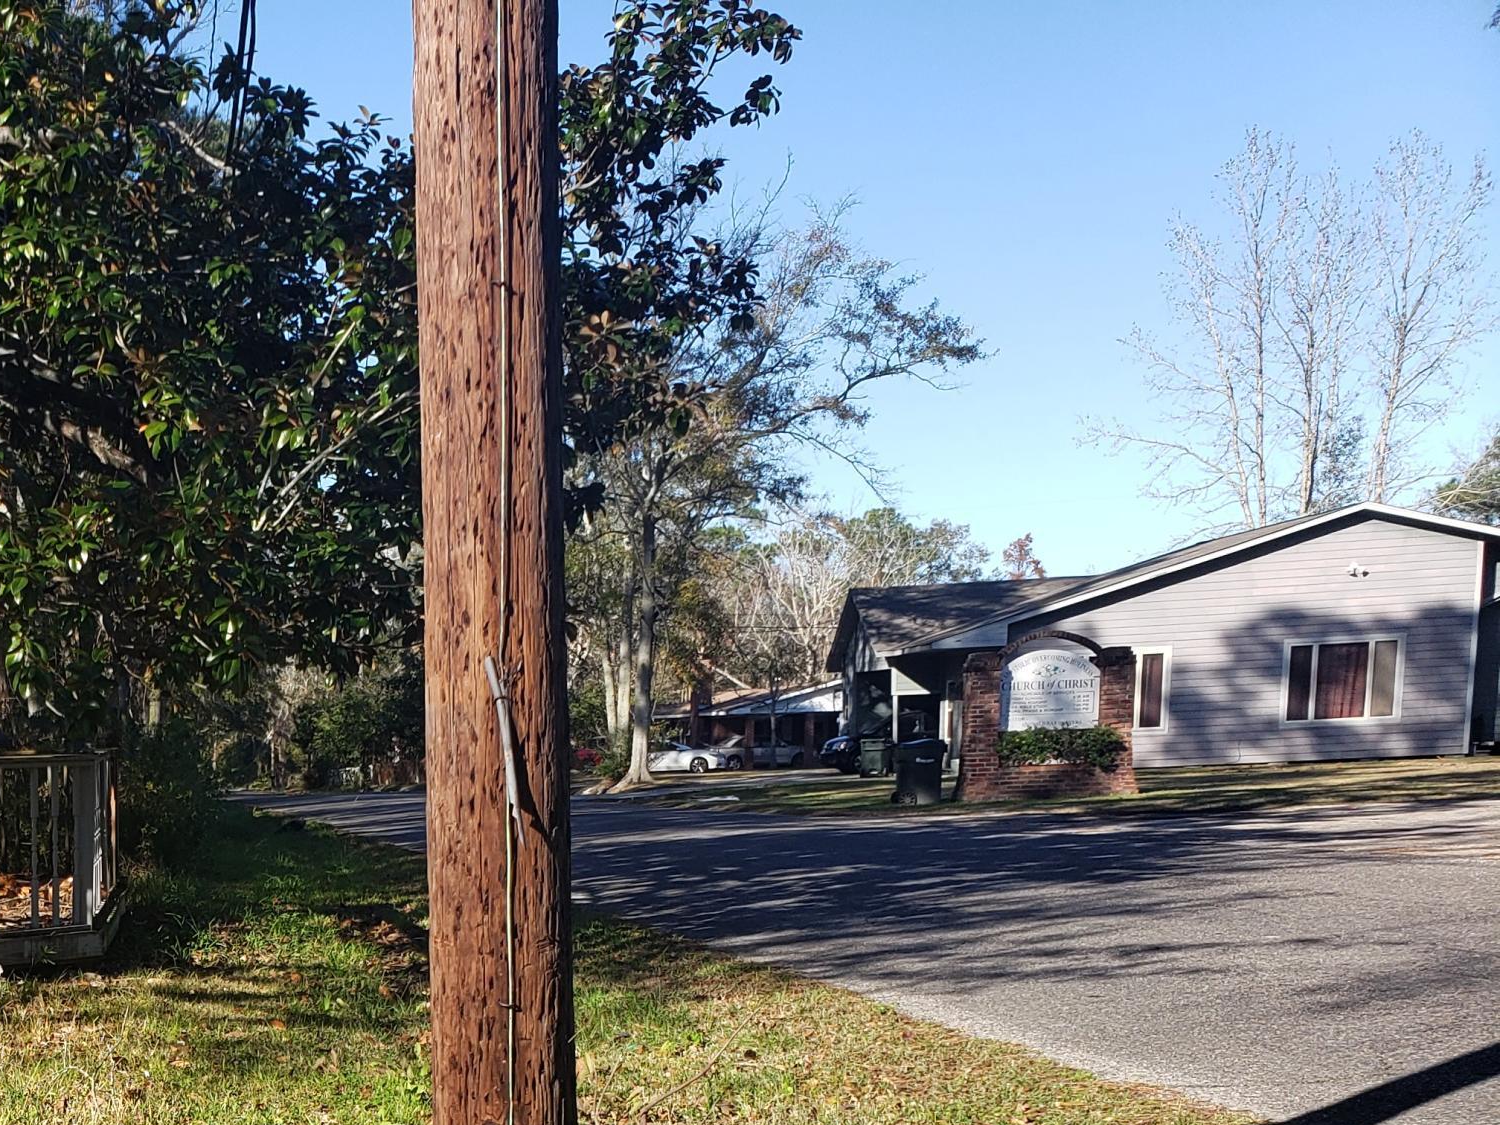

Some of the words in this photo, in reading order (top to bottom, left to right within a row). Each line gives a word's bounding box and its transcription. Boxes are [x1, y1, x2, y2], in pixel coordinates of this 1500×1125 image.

[1031, 654, 1069, 663] OVERCOMING
[1001, 680, 1045, 691] CHURCH
[1047, 679, 1055, 690] of
[1057, 678, 1095, 689] CHRIST
